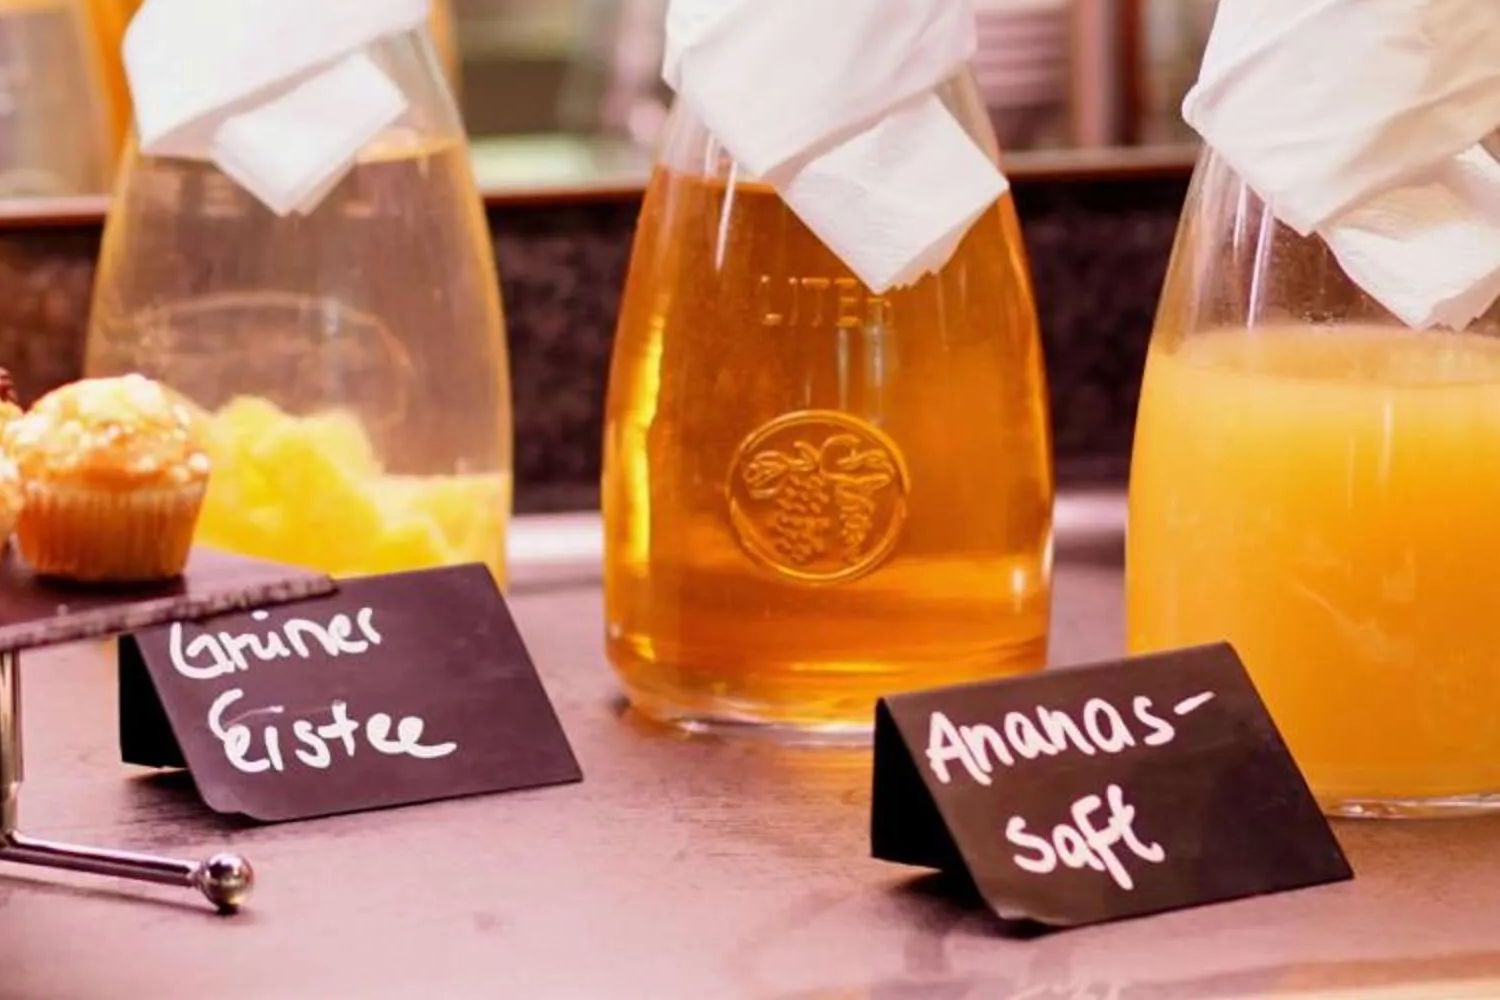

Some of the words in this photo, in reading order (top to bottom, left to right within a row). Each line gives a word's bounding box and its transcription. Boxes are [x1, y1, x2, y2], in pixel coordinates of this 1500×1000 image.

[169, 608, 381, 679] Grüner
[208, 688, 457, 773] Eistee
[925, 691, 1215, 785] Ananas-
